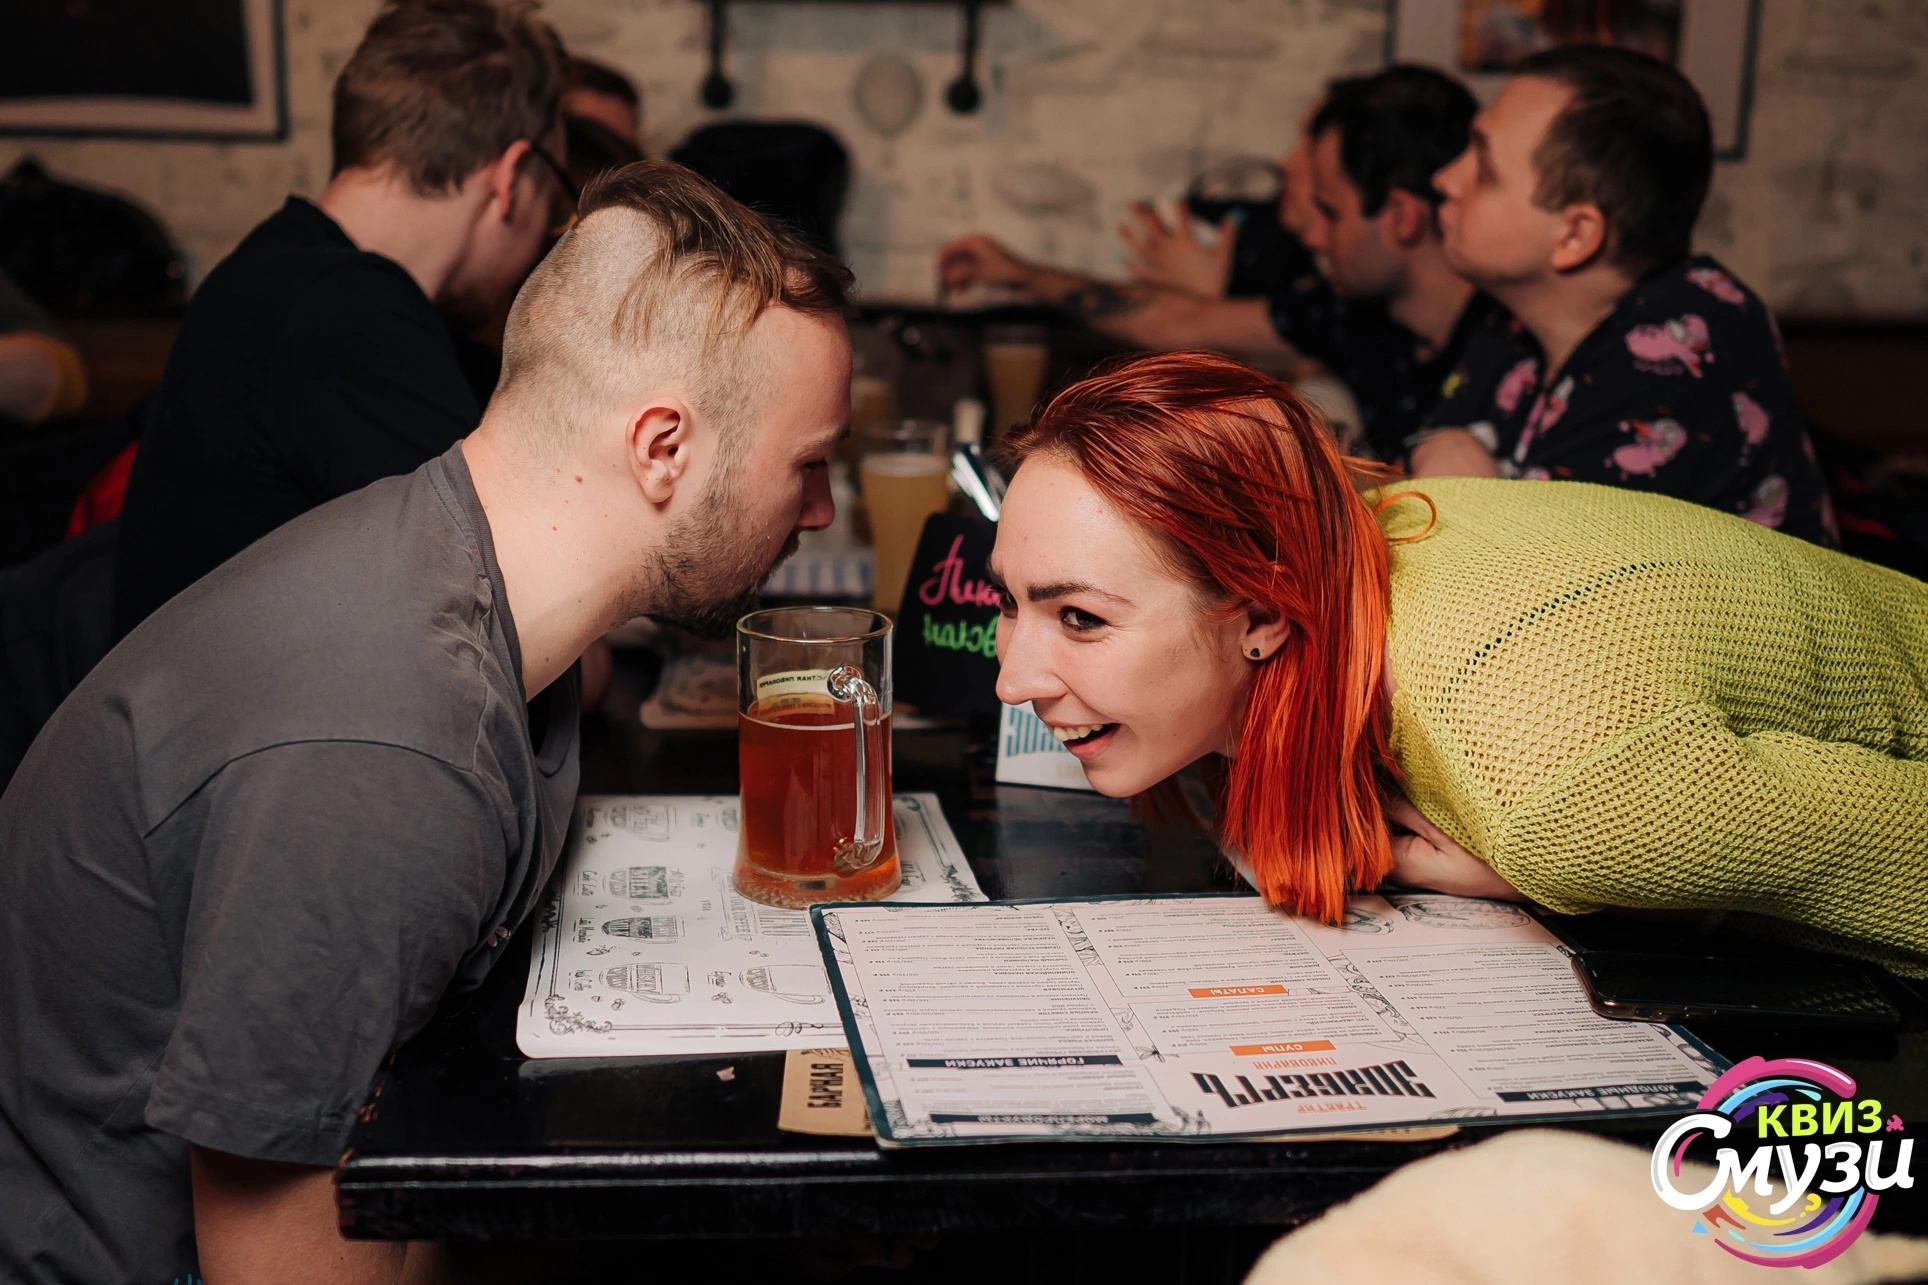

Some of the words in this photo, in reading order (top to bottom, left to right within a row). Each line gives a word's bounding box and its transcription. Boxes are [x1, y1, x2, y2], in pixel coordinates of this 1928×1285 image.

[732, 911, 751, 933] COFFEE
[1210, 986, 1265, 997] САЛАТЫ
[1262, 1043, 1304, 1054] СУПЫ
[944, 1057, 1014, 1067] ЗАКУСКИ
[1018, 1056, 1085, 1066] ГОРЯЧИЕ
[1252, 1057, 1338, 1070] ПИВОВАРНЯ
[807, 1063, 844, 1108] БАРНАЯ
[1596, 1083, 1679, 1096] ХОЛОДНЫЕ
[1527, 1087, 1592, 1100] ЗАКУСКИ
[1297, 1102, 1367, 1114] ТРАКТИР
